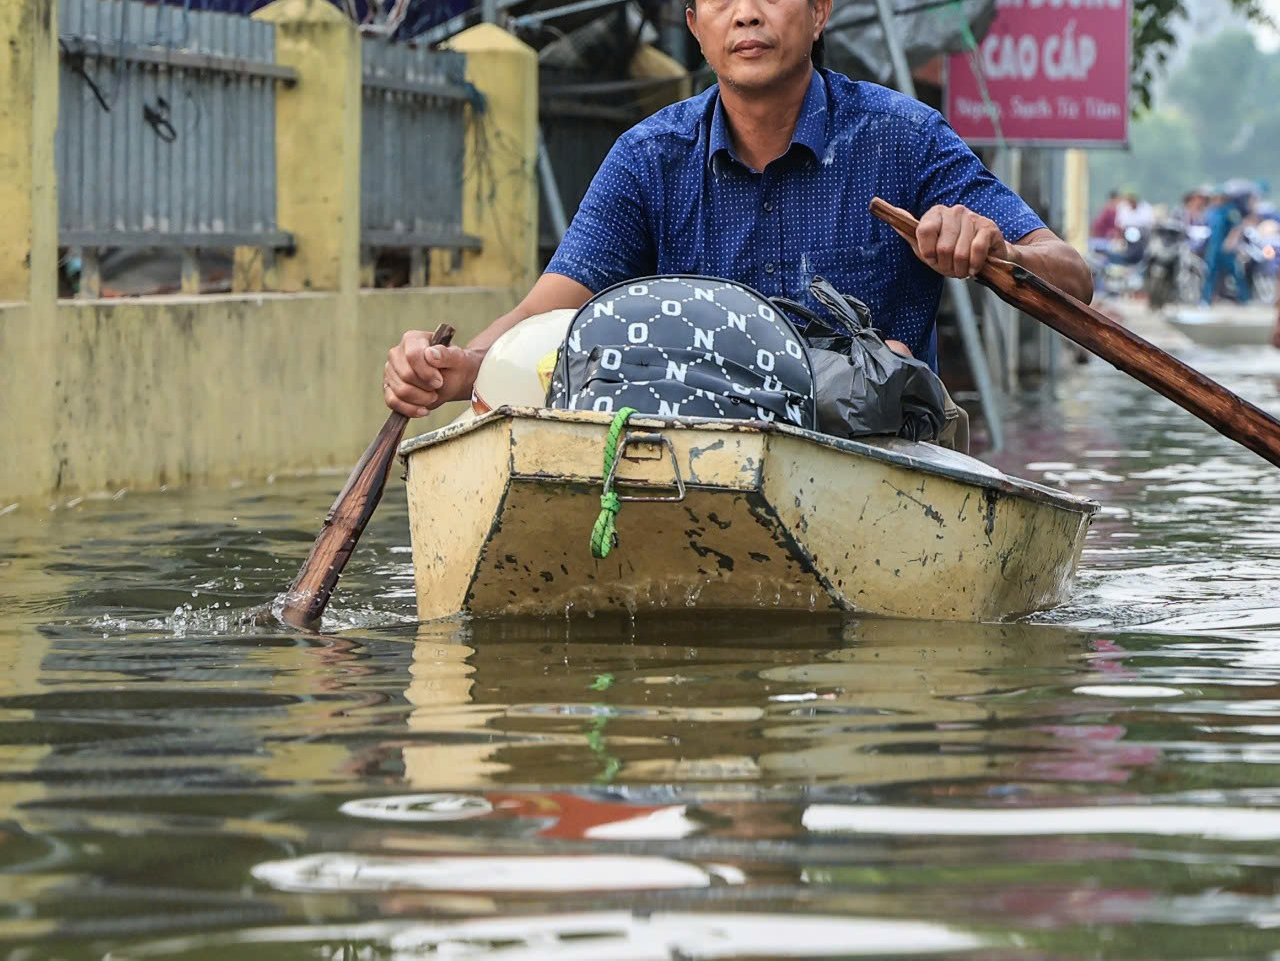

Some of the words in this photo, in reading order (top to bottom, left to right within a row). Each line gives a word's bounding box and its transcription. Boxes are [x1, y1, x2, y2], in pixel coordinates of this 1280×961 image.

[984, 34, 1038, 81] CAO
[1042, 18, 1097, 81] CẤP
[628, 285, 648, 296] O
[694, 288, 714, 302] N
[593, 301, 614, 318] N
[661, 300, 682, 316] O
[758, 304, 775, 322] O
[727, 311, 746, 332] N
[628, 322, 648, 343] O
[693, 328, 714, 351] N
[600, 348, 622, 370] O
[786, 339, 802, 359] O
[757, 349, 775, 372] O
[666, 360, 688, 383] N
